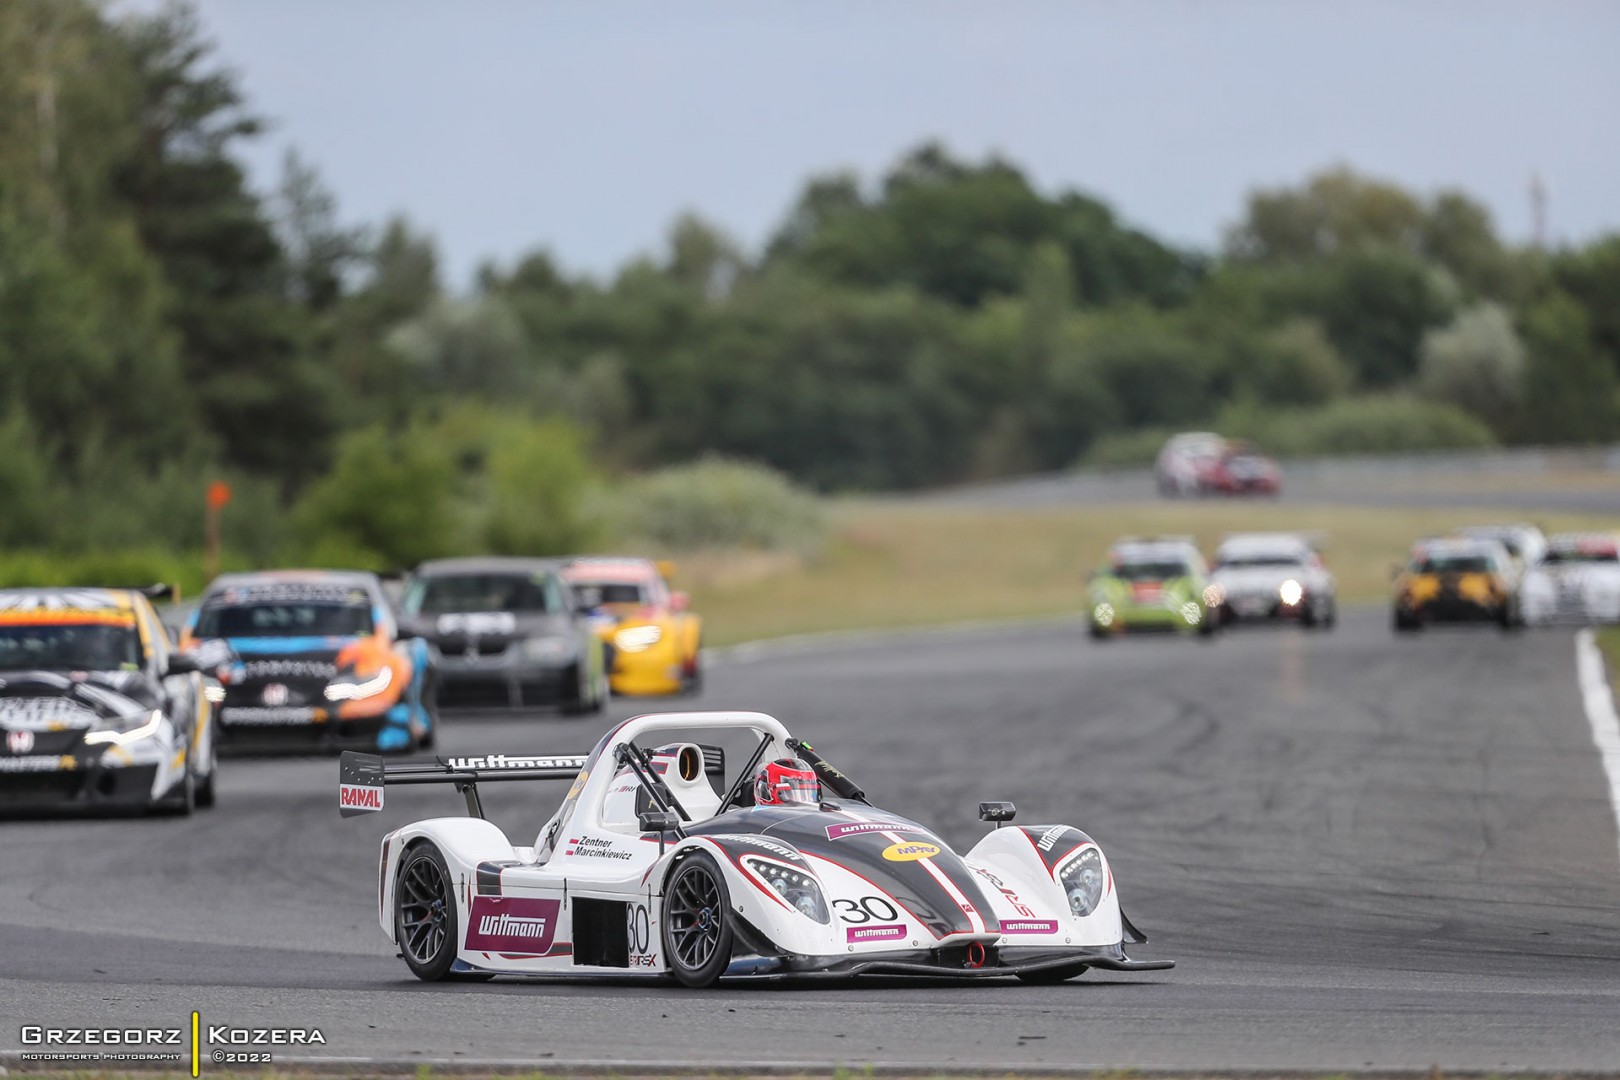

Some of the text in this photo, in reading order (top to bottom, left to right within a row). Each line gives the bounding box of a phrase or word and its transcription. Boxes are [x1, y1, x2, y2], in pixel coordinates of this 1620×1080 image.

[579, 836, 613, 848] Zentner
[574, 846, 633, 861] Marcinkiewicz
[831, 896, 898, 924] 30
[625, 903, 650, 955] 30
